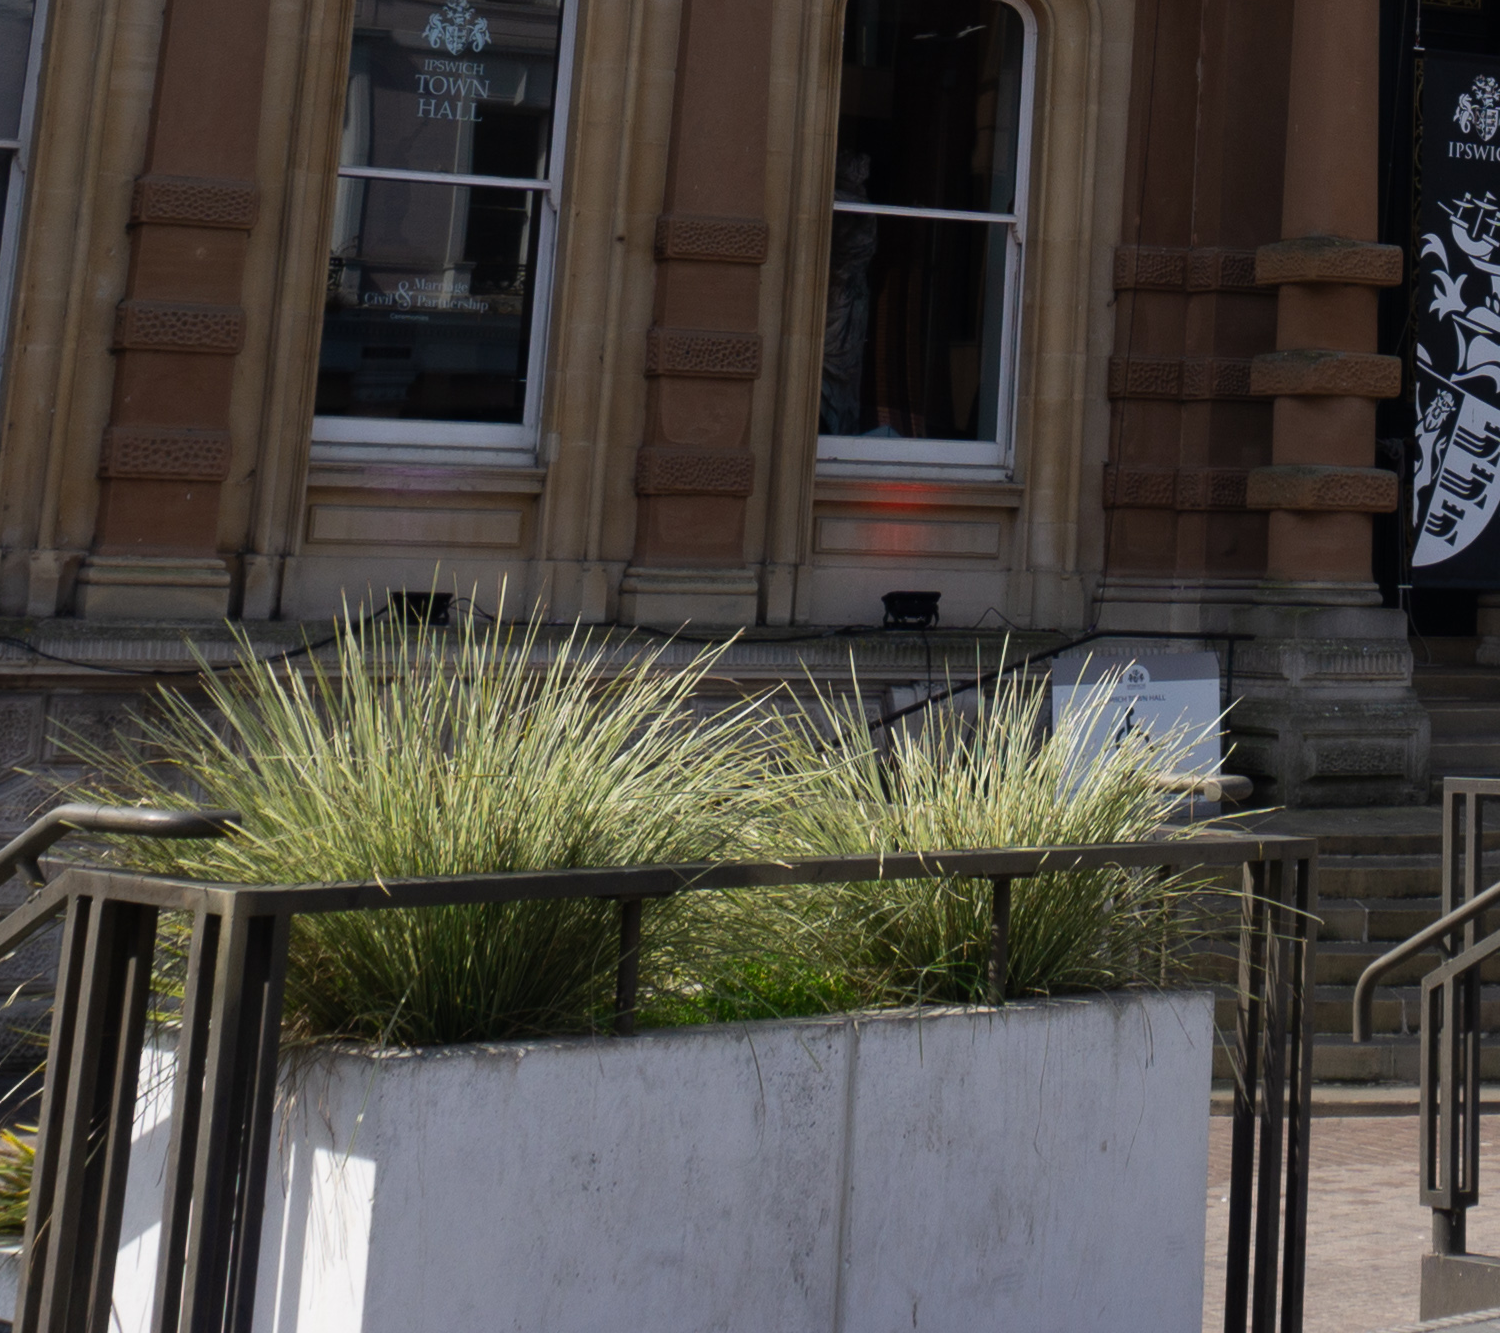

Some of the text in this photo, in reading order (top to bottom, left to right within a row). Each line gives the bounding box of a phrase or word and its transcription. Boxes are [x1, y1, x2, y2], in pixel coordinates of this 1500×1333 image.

[424, 59, 484, 75] IPSWICH
[415, 74, 490, 98] TOWN
[417, 98, 483, 122] HALL
[364, 291, 393, 305] Civil
[395, 280, 414, 311] &
